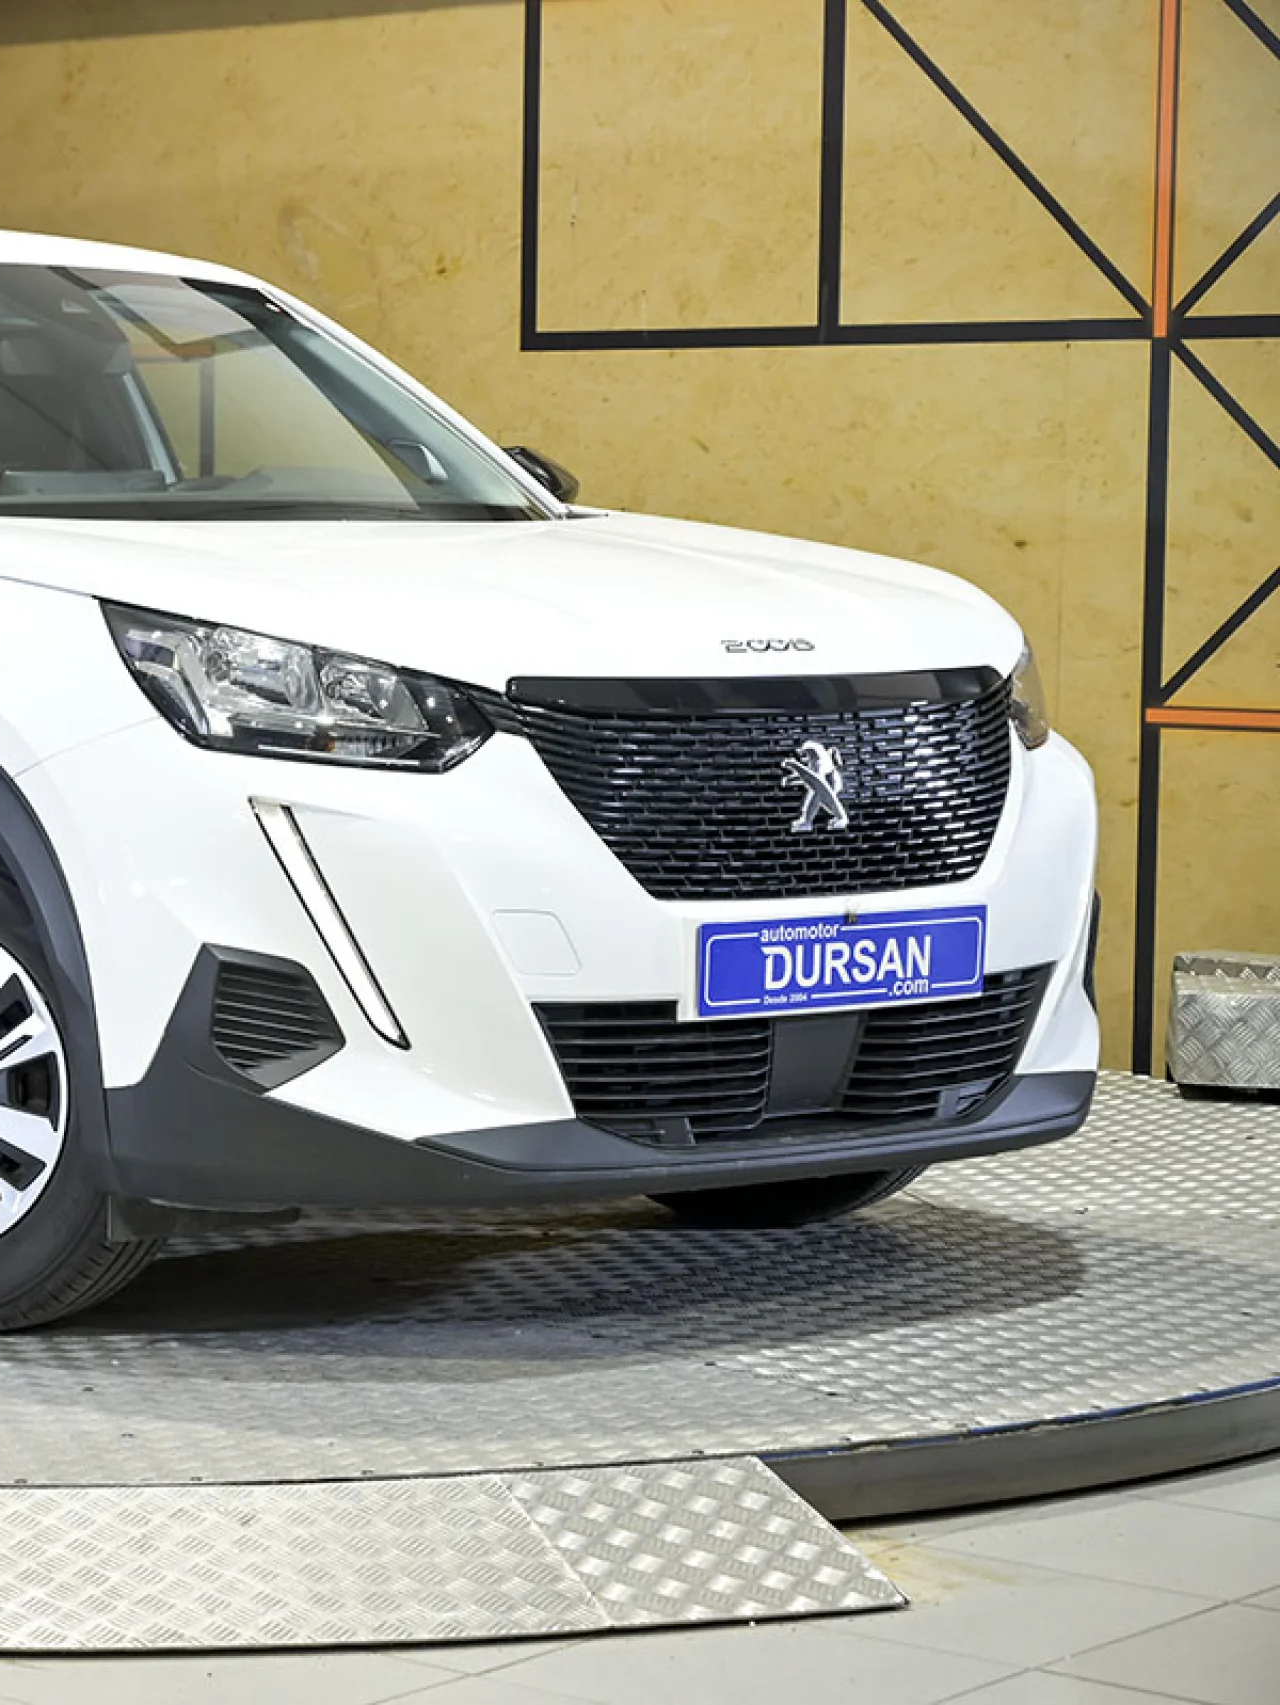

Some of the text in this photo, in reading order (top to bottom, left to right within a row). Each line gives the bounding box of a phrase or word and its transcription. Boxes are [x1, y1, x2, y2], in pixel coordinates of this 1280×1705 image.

[760, 922, 839, 942] automotor
[761, 935, 931, 990] DURSAN
[889, 977, 929, 997] .com
